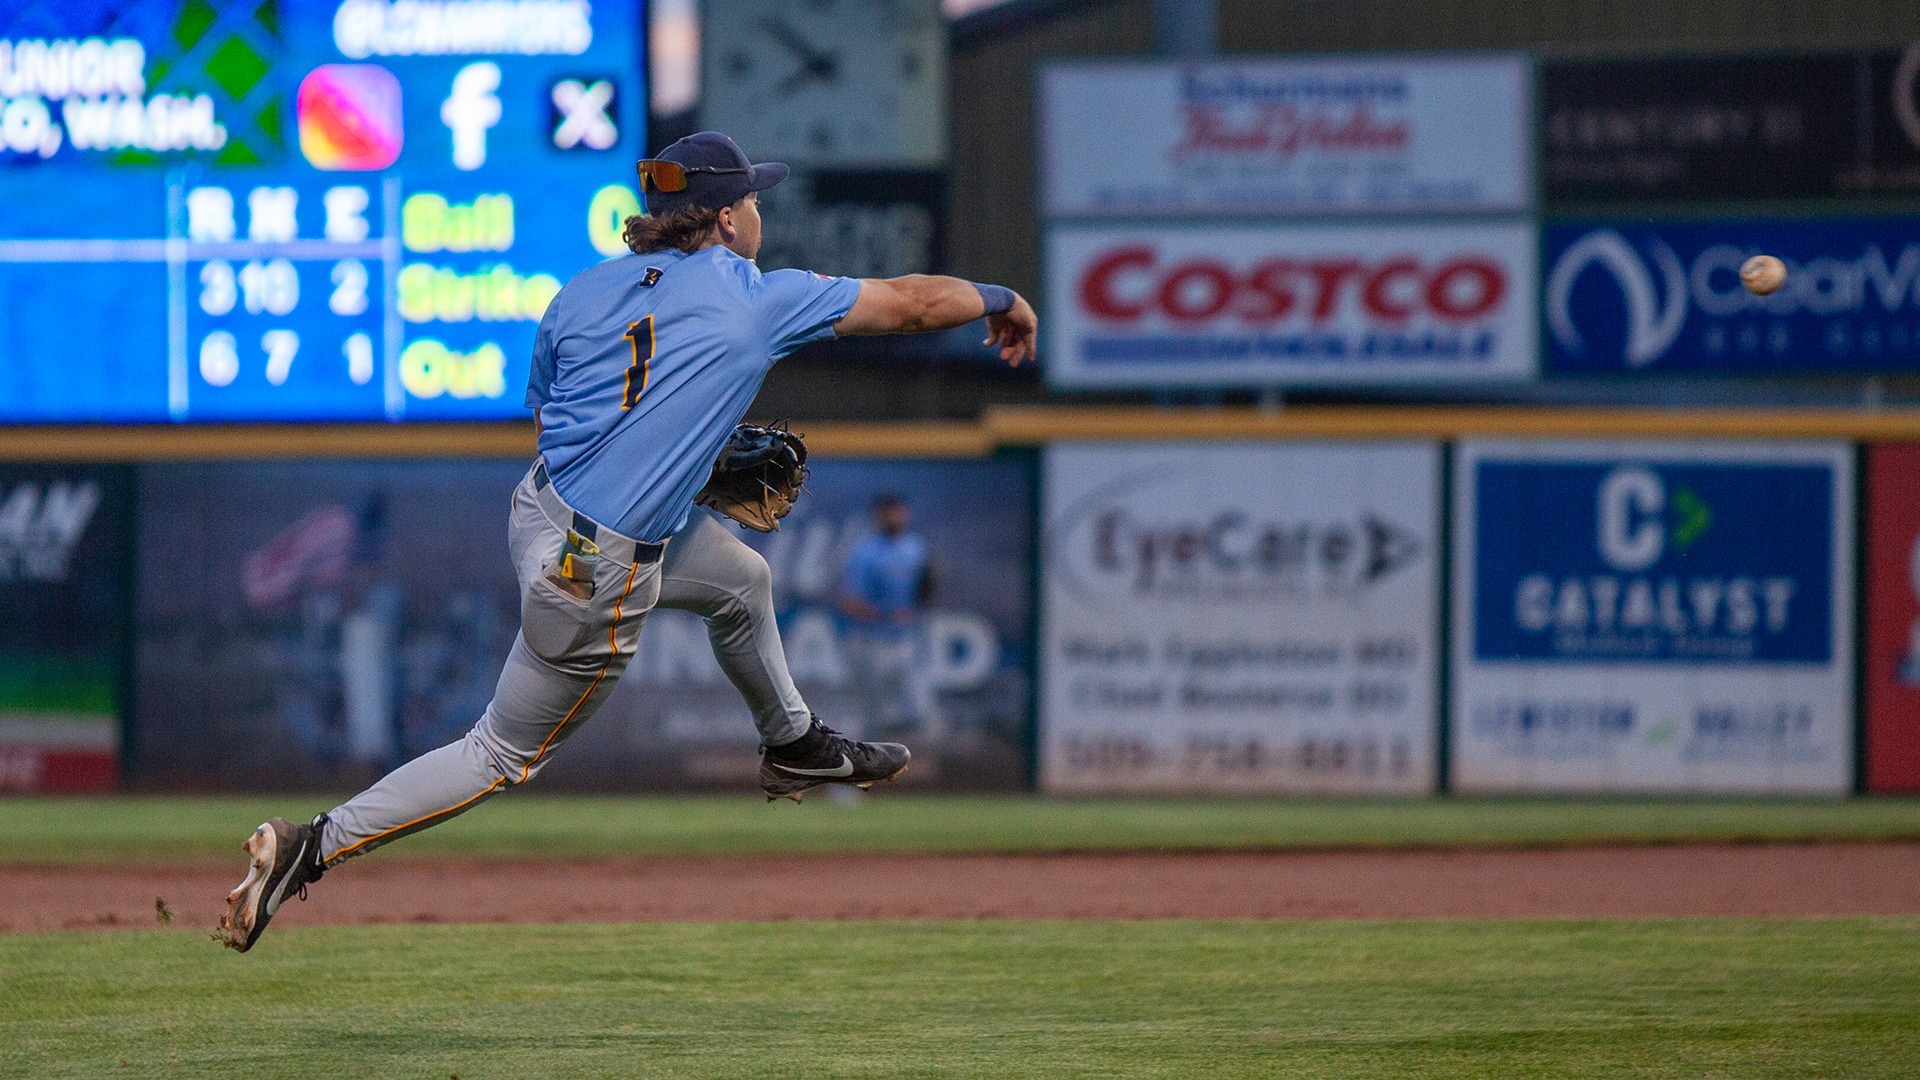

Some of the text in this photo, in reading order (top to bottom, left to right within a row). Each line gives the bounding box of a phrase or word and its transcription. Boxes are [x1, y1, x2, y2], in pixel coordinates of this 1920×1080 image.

[62, 93, 228, 151] WASH.
[188, 186, 235, 241] R
[325, 186, 370, 242] E
[402, 193, 514, 252] Ball
[200, 260, 238, 315] 3
[330, 260, 369, 315] 2
[397, 262, 563, 323] Strike
[200, 329, 374, 386] 6 7 1
[399, 339, 507, 399] Out
[623, 314, 656, 411] 1
[1516, 573, 1797, 634] CATALYST
